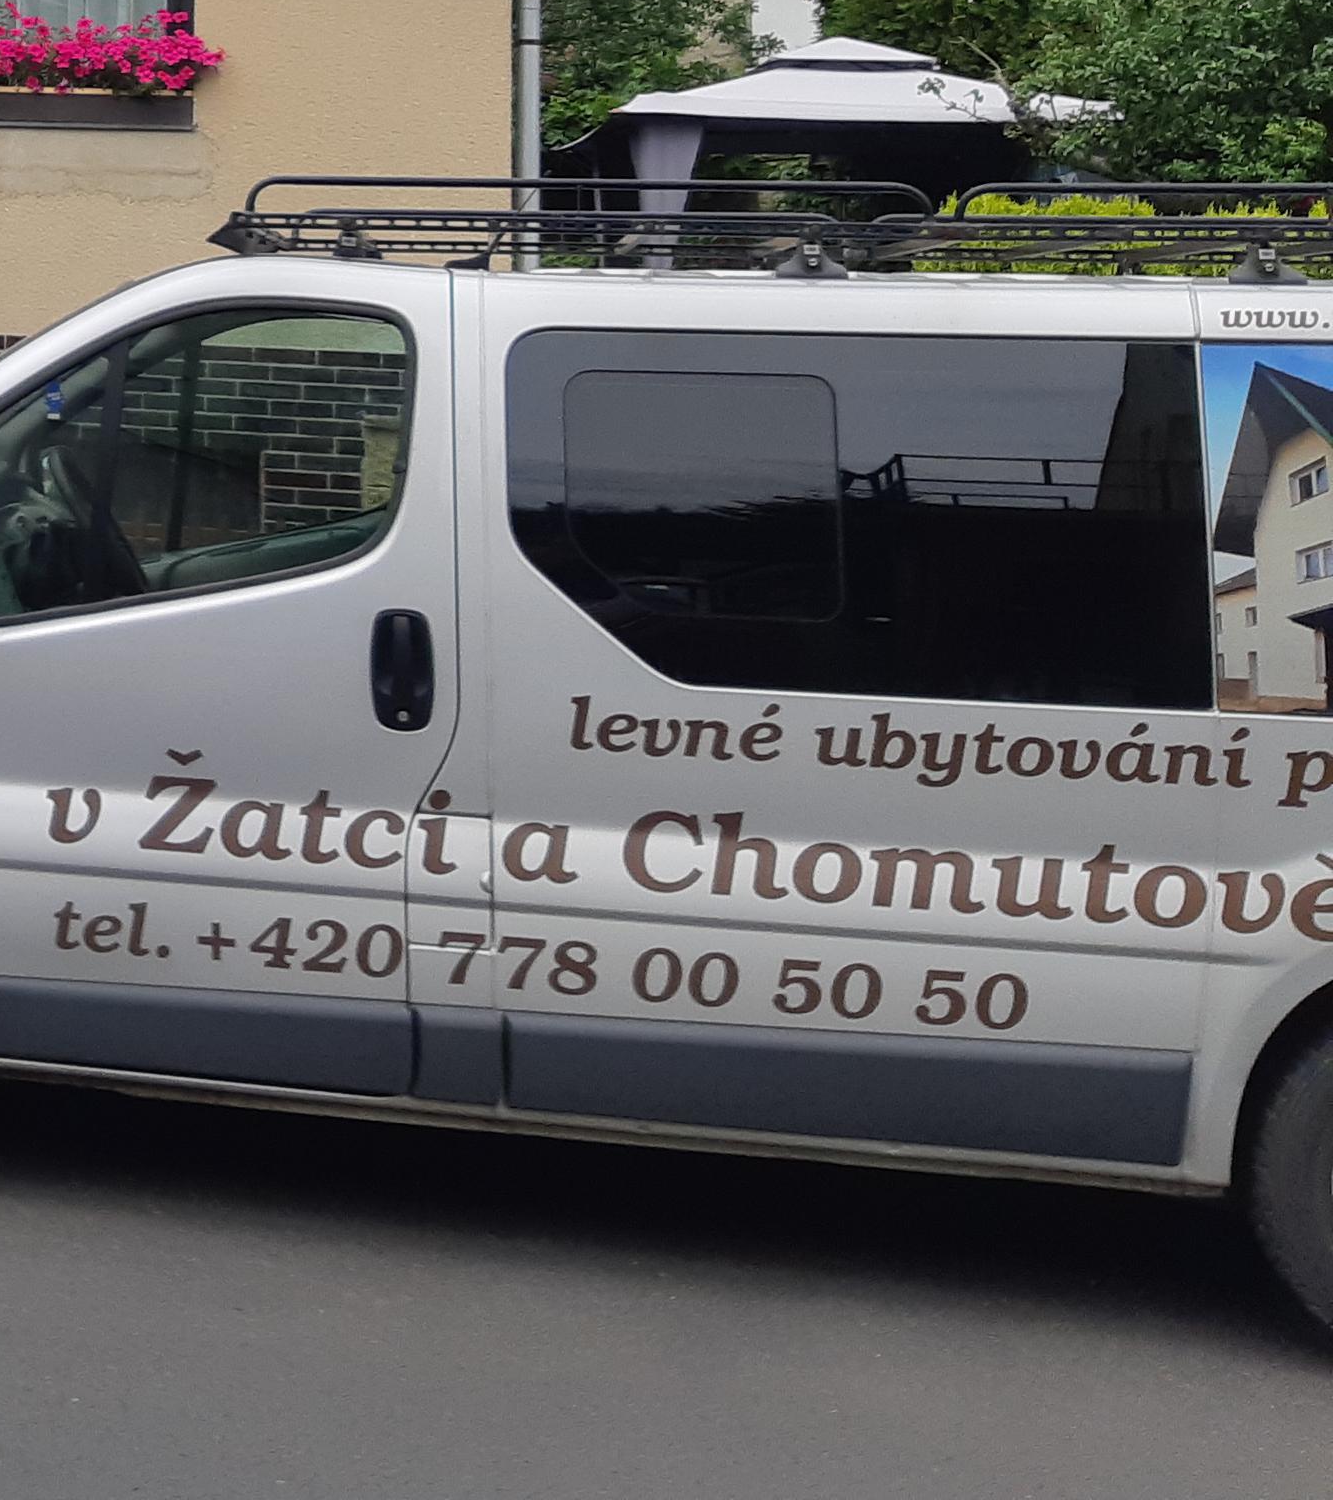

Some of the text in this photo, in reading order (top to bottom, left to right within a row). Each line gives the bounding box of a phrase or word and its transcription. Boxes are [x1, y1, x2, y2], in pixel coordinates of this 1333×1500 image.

[1220, 310, 1331, 329] www.
[569, 695, 783, 762] levné
[814, 712, 1252, 788] ubytování
[46, 787, 101, 844] v
[138, 748, 458, 875] Žatci
[501, 821, 578, 883] a
[53, 901, 1029, 1030] tel. +420 778 00 50 50
